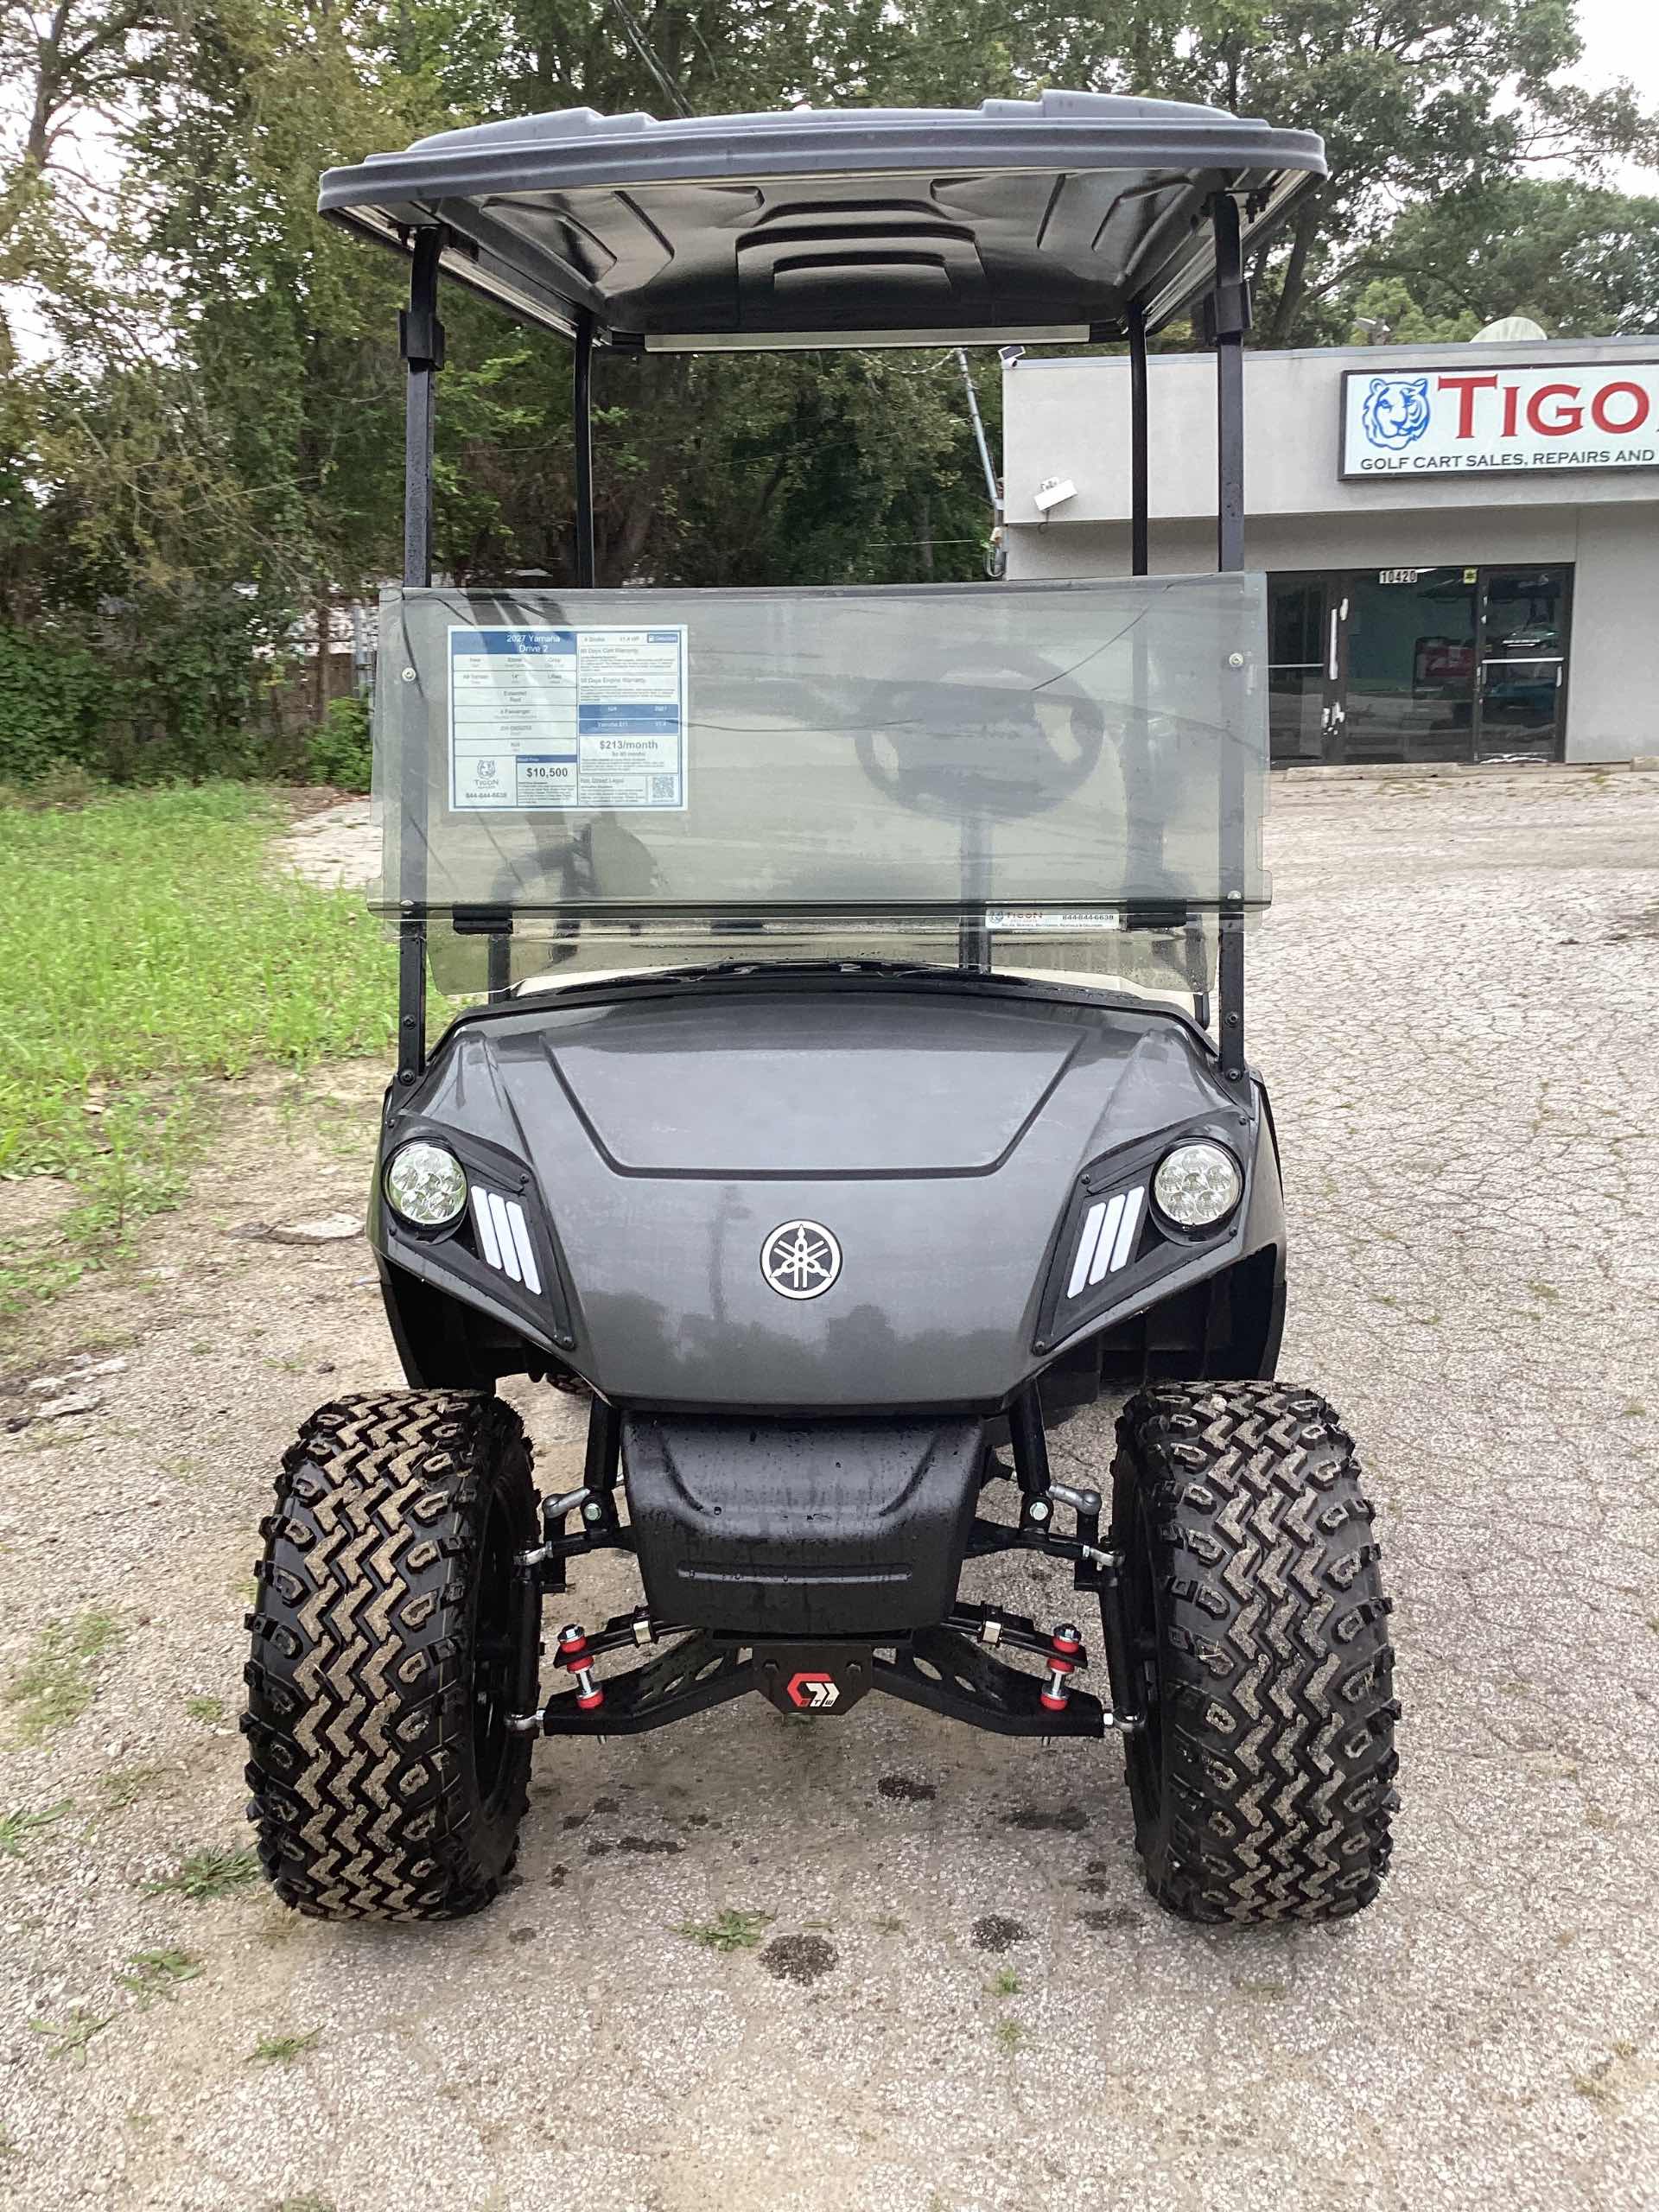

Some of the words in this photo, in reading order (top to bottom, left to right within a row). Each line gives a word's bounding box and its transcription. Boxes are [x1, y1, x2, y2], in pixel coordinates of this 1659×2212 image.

[1438, 373, 1659, 439] TIGO
[1360, 456, 1410, 470] GOLF
[1413, 454, 1463, 469] CART
[1465, 453, 1529, 467] SALES,
[1532, 450, 1611, 465] REPAIRS
[1615, 448, 1655, 462] AND
[1381, 569, 1417, 583] 10420
[506, 634, 526, 643] 2027
[529, 634, 561, 643] Yamaha
[600, 739, 658, 750] $213/month
[526, 767, 569, 778] $10,500
